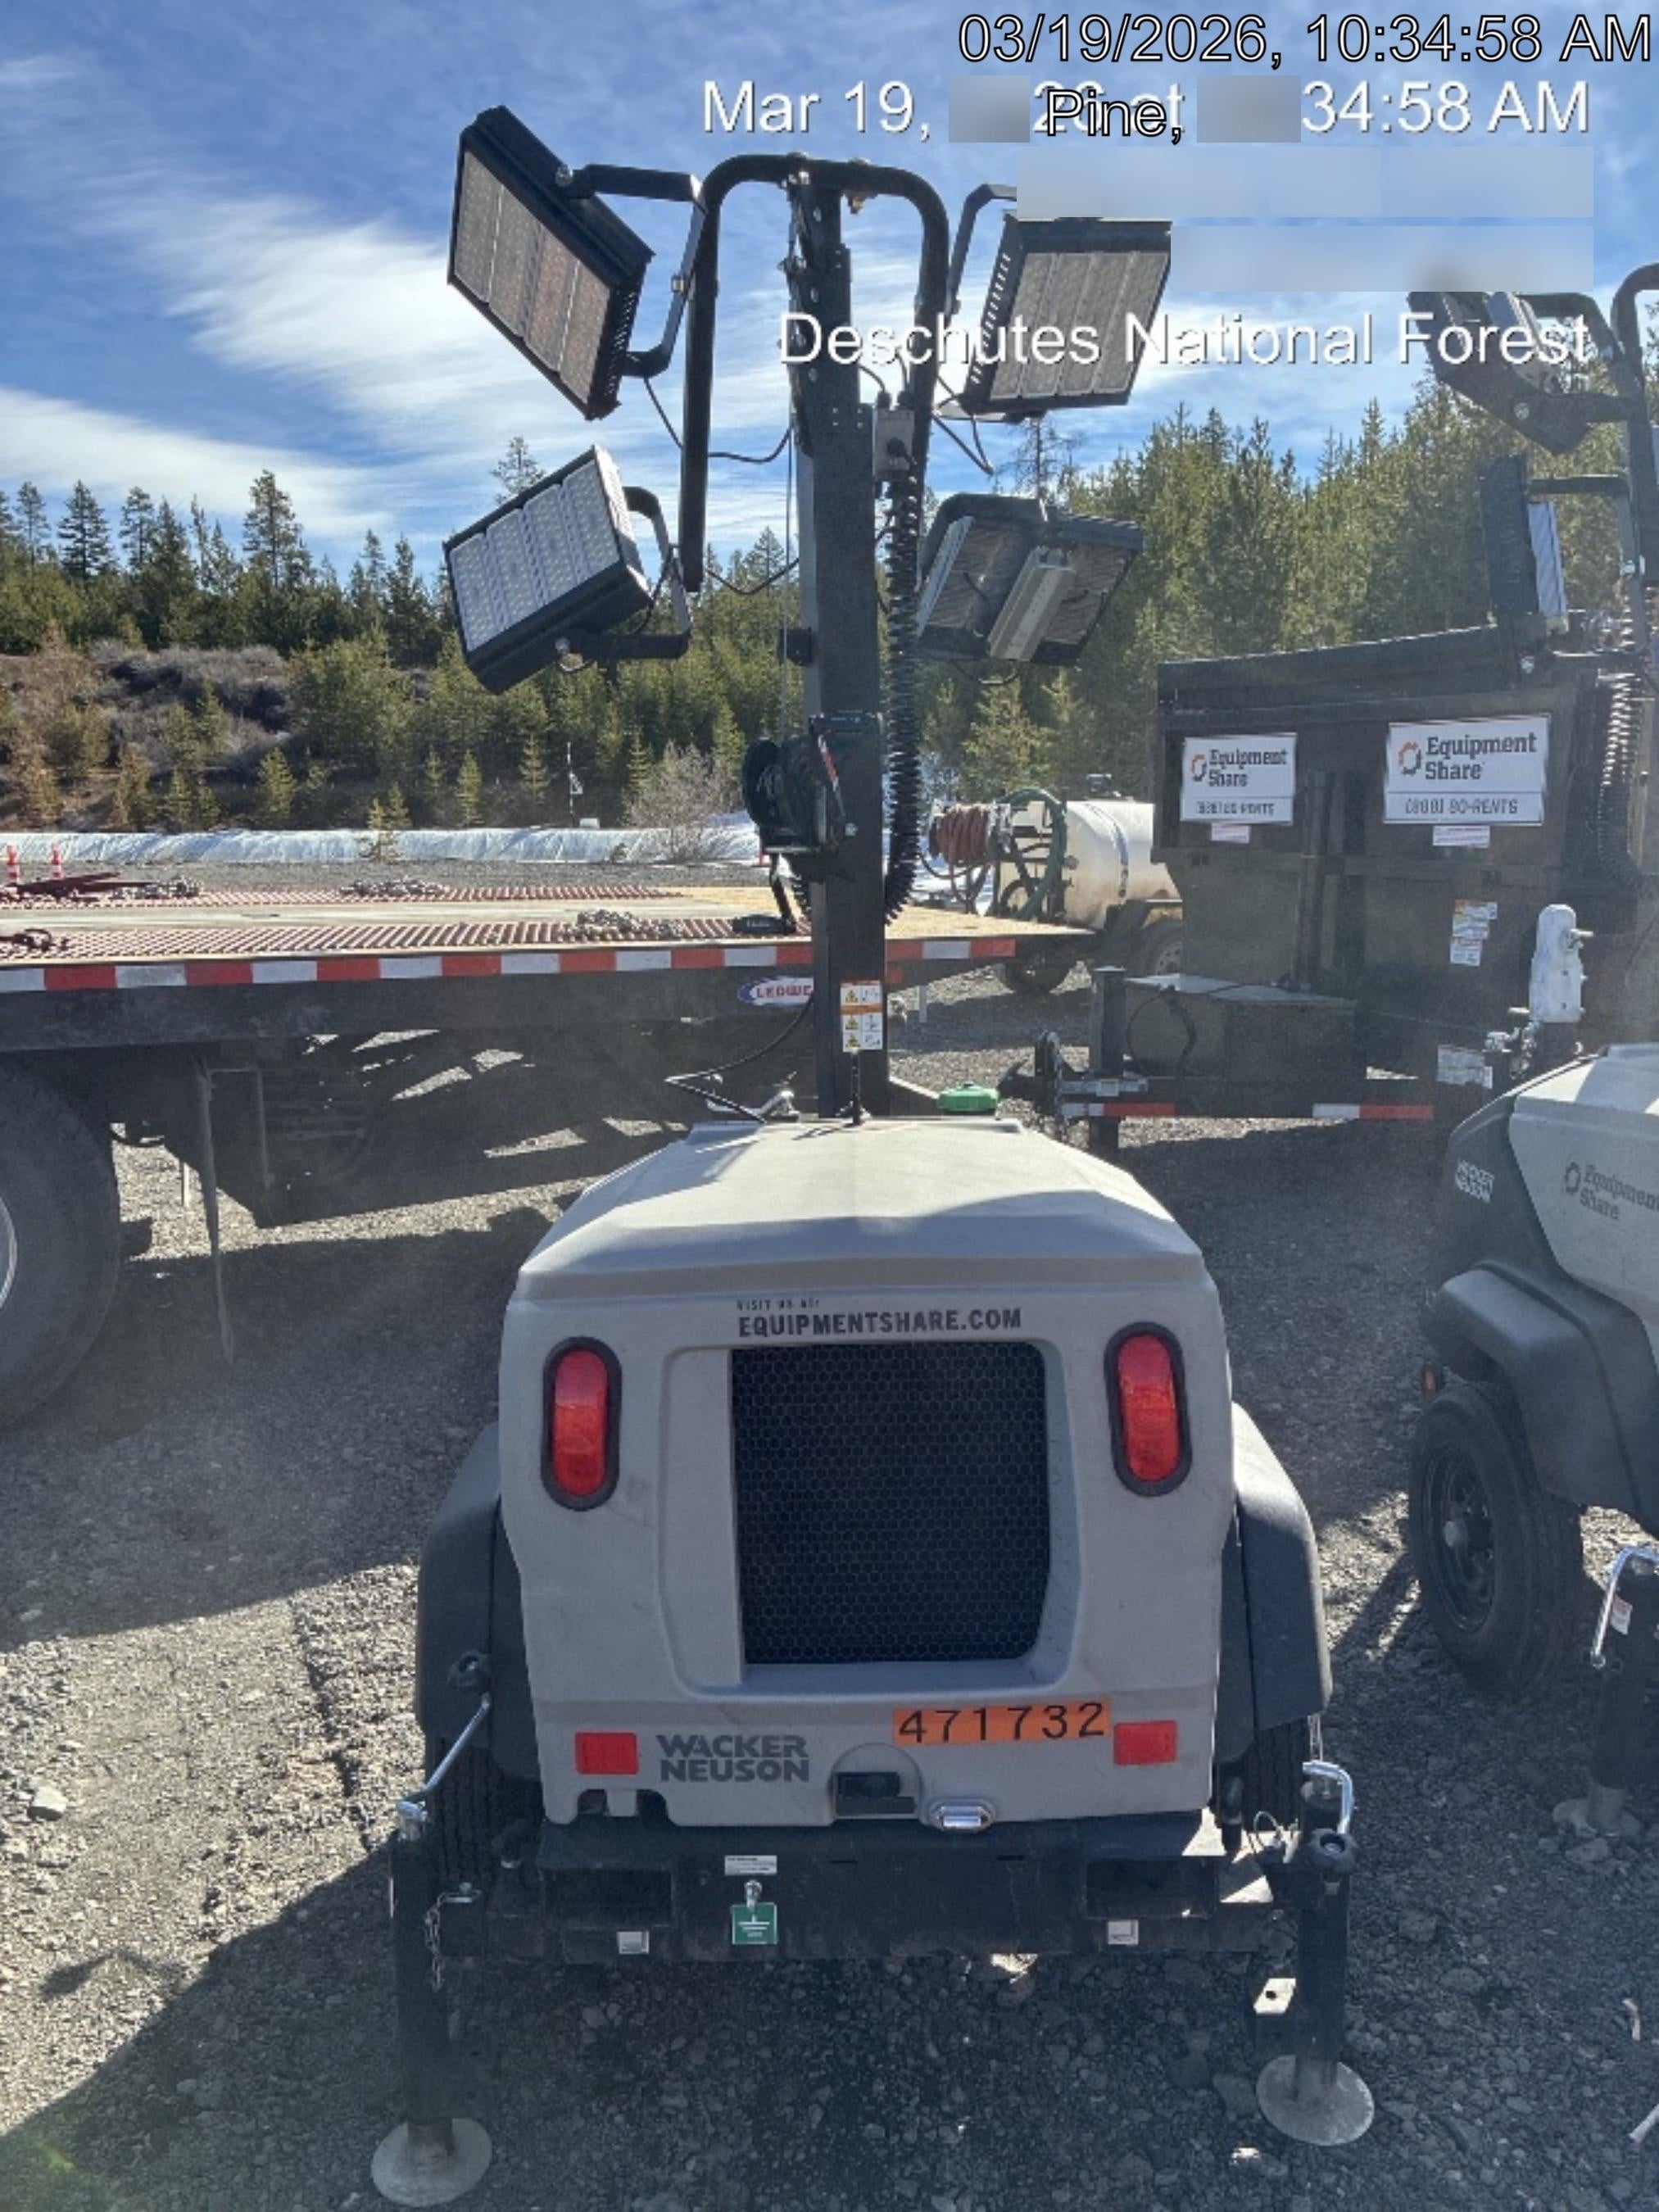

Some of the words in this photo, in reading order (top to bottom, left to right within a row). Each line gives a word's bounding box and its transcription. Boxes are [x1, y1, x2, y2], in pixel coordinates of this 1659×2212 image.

[1426, 732, 1537, 759] Equipment
[1209, 749, 1287, 770] Equipment
[1426, 761, 1483, 780] Share
[739, 1309, 1021, 1337] EQUIPMENTSHARE.COM
[899, 1702, 1106, 1743] 471732
[656, 1734, 809, 1758] WACKER
[659, 1759, 810, 1783] NEUSON
